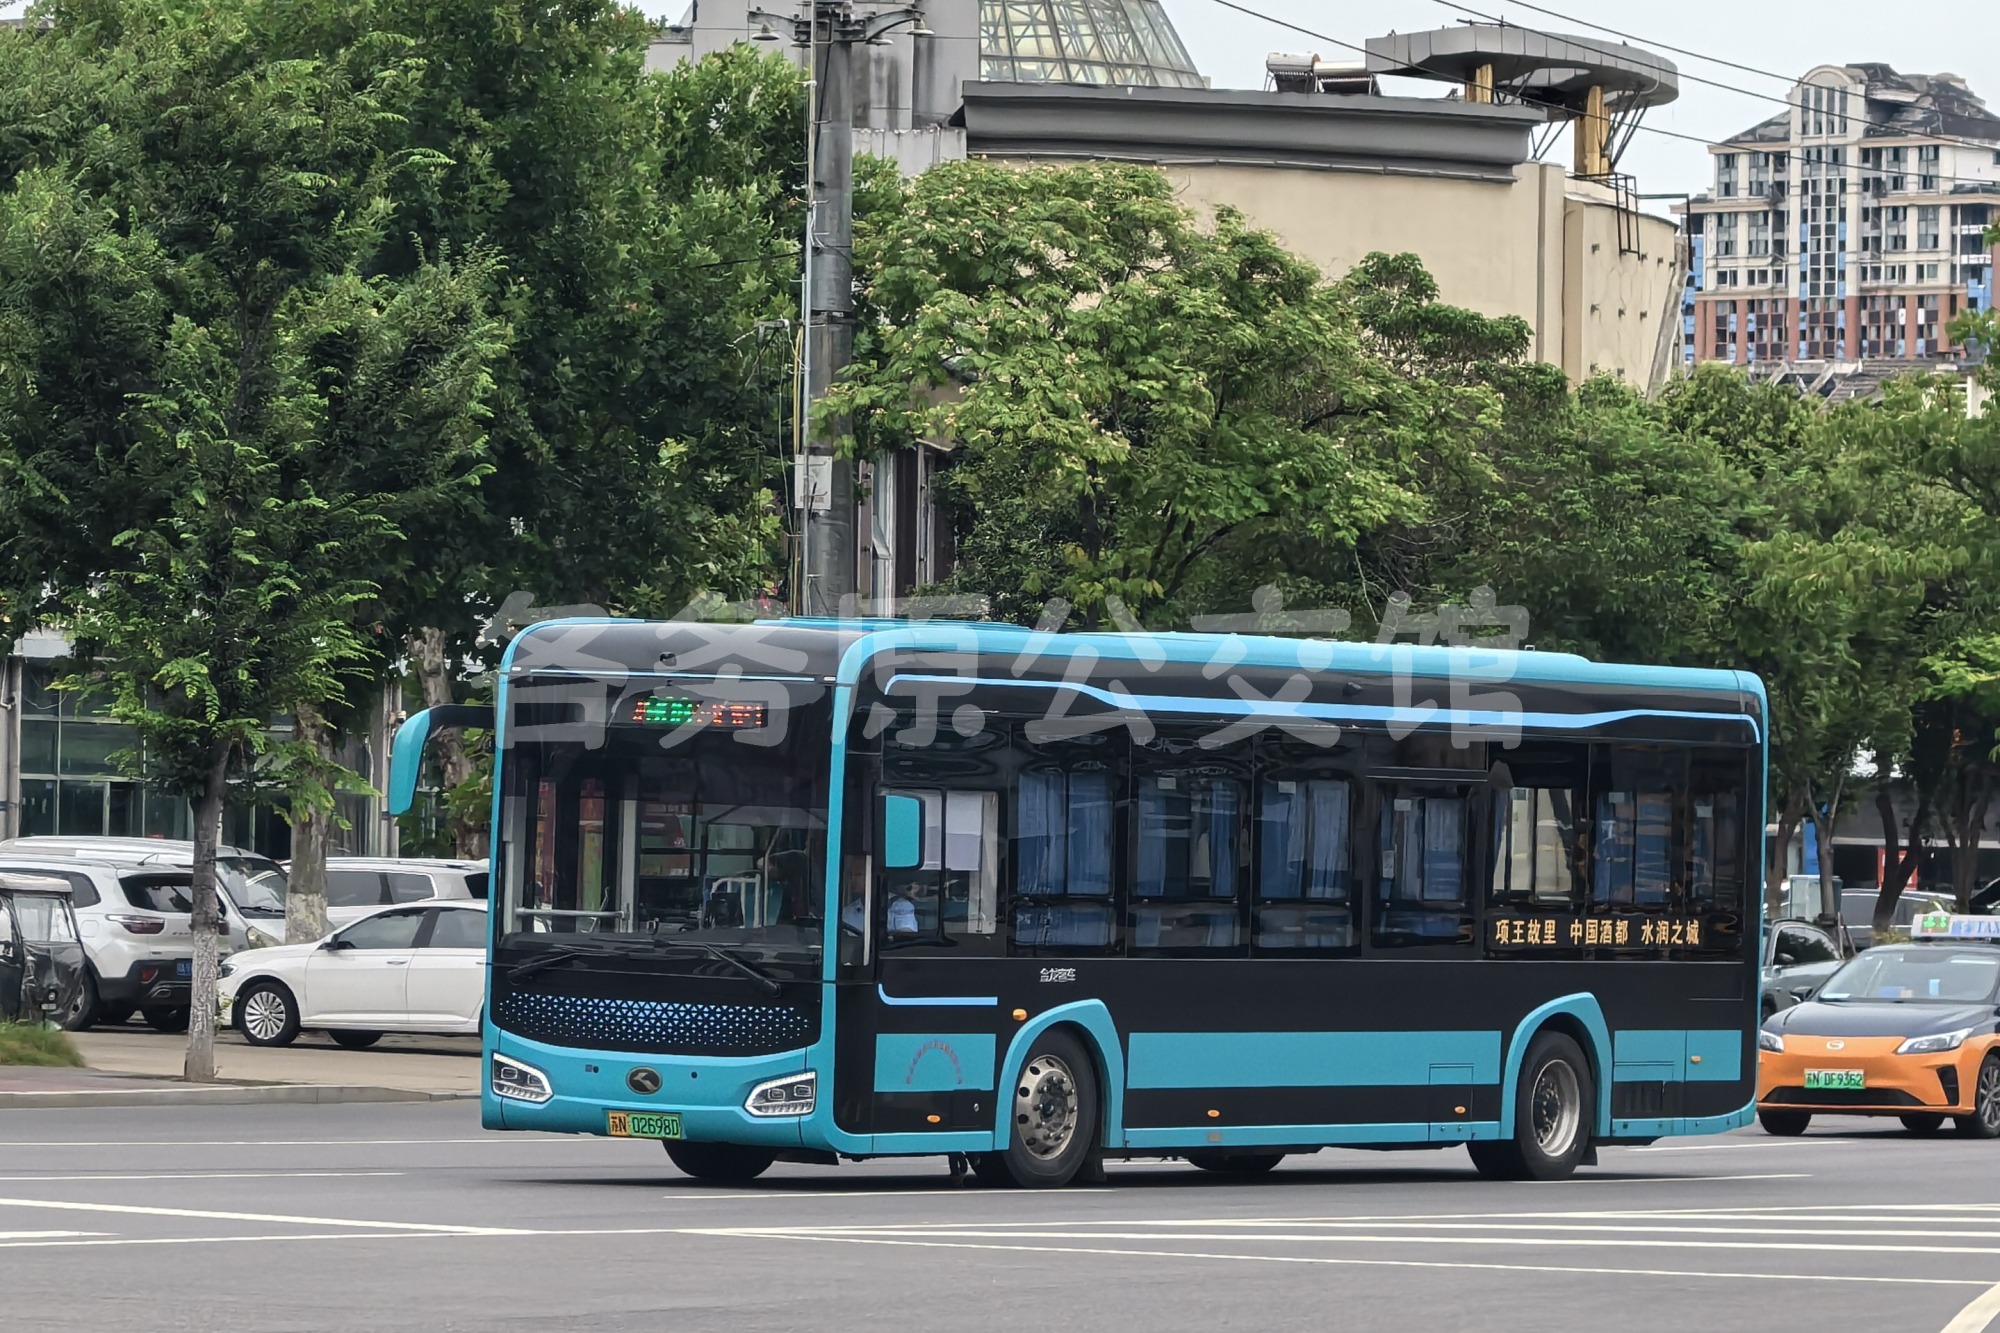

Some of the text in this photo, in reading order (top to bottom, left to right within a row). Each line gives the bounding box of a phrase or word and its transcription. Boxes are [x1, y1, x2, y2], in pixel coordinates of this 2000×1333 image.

[1495, 918, 1700, 945] 项王故里 中国酒都 水润之城
[633, 1117, 679, 1135] 02698D
